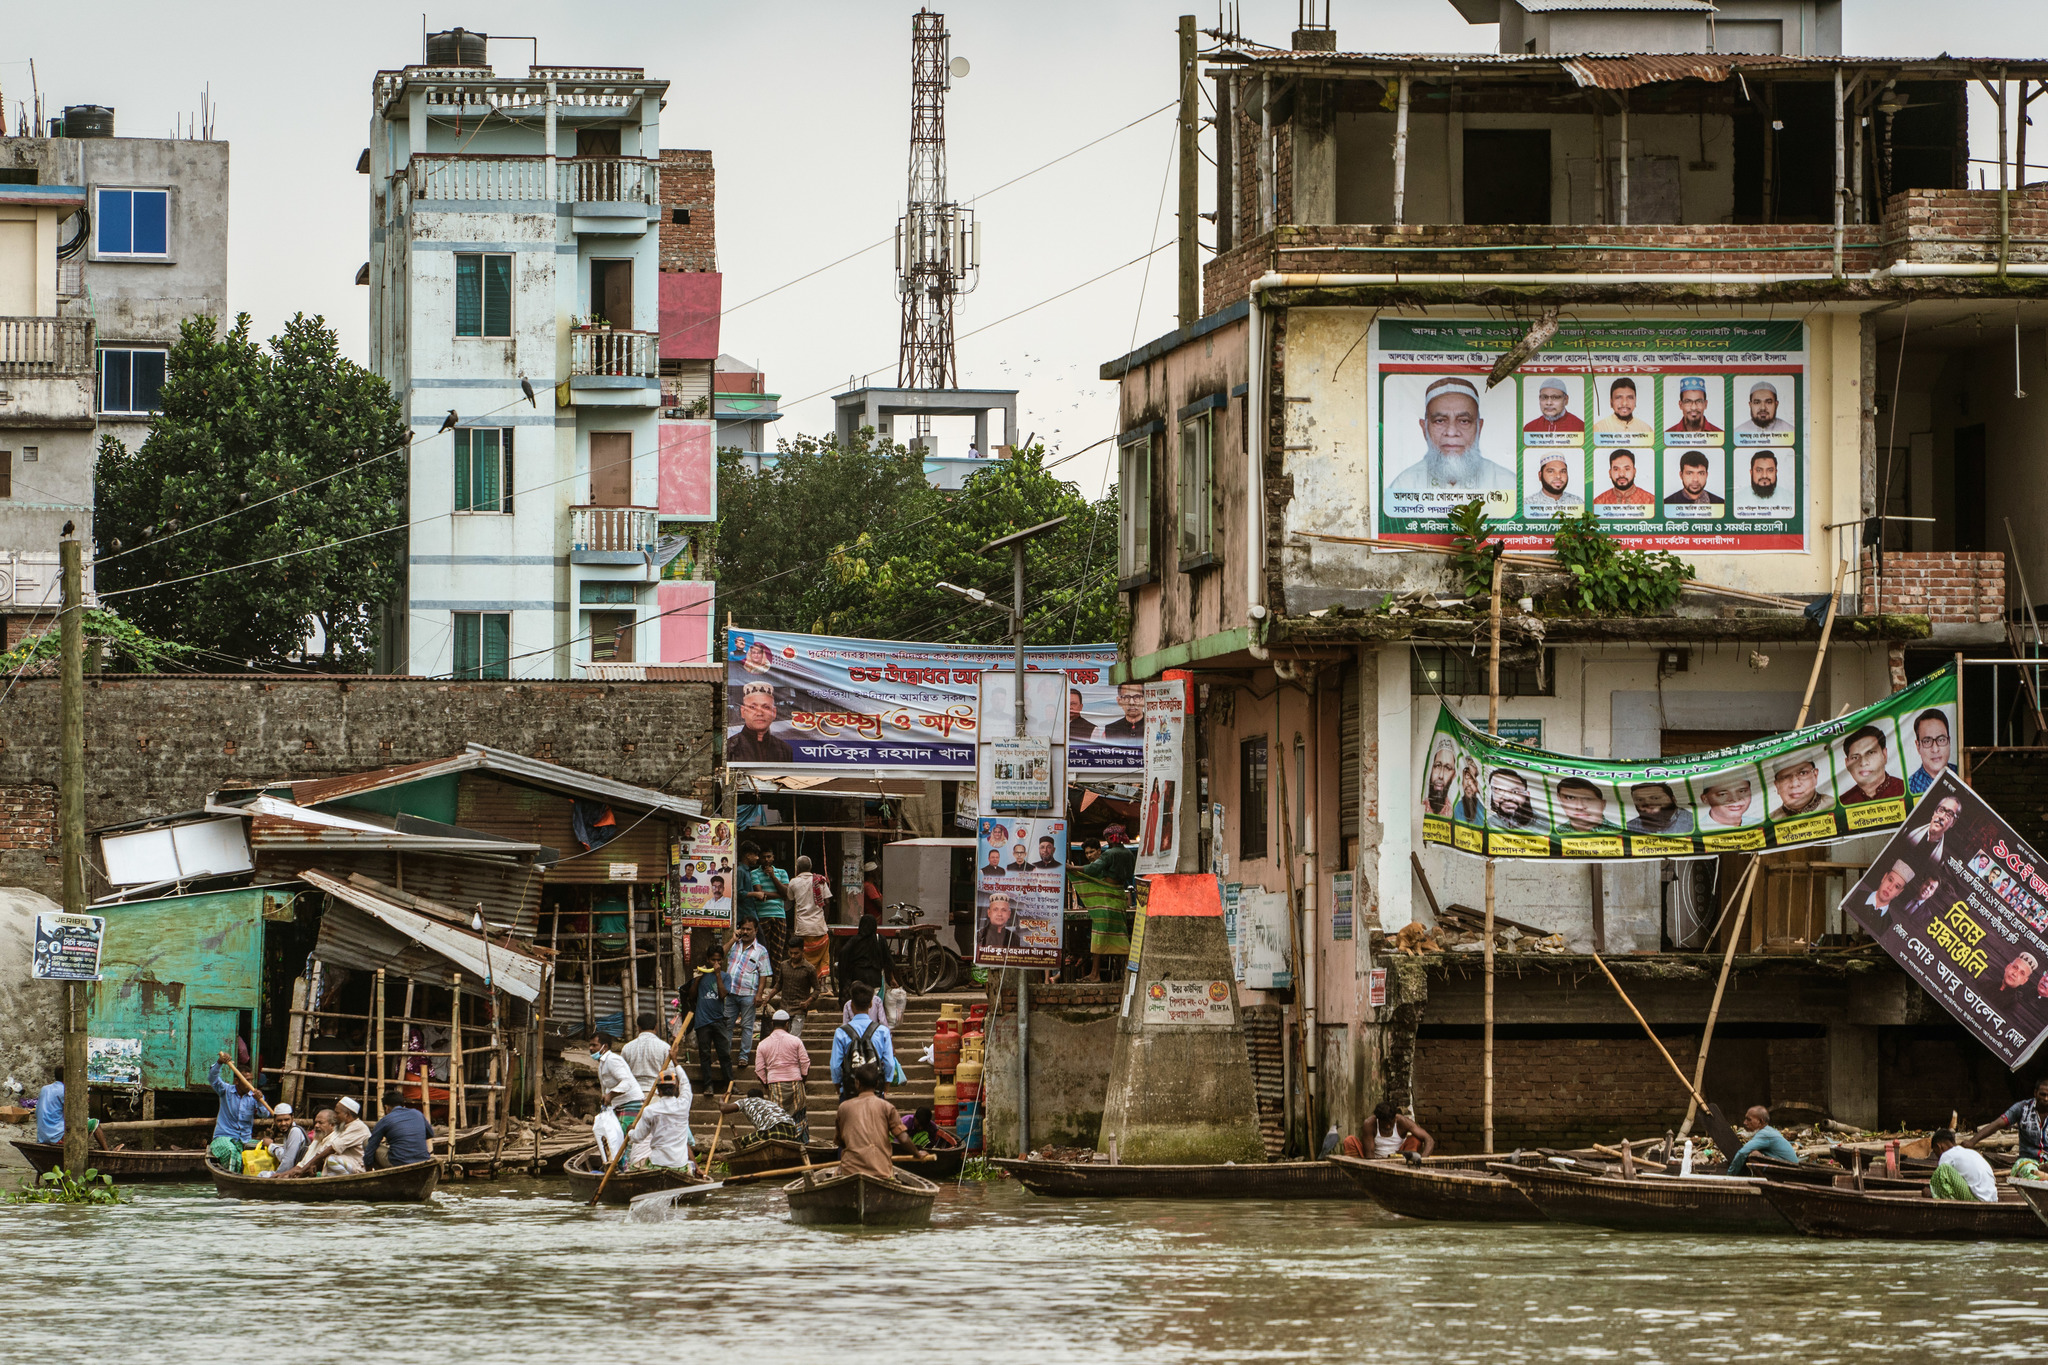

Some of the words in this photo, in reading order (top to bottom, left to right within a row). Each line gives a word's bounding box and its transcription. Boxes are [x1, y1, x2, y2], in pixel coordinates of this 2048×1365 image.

[1656, 338, 1730, 349] নির্বাচনে
[1393, 504, 1425, 514] সভাপতি
[1405, 521, 1418, 532] এই
[1421, 521, 1449, 532] পরিষদ
[1612, 520, 1663, 533] ব্যবসায়ীদের
[1665, 520, 1689, 532] নিকট
[1715, 522, 1722, 532] ও
[1724, 521, 1752, 533] সমর্থন
[1502, 536, 1543, 545] সোসাইটির
[1656, 536, 1690, 545] মার্কেটের
[848, 666, 882, 683] শুভ
[883, 663, 951, 685] উদ্বোধন
[900, 691, 939, 703] আমন্ত্রিত
[942, 693, 967, 703] সকল
[890, 706, 912, 731] ও
[918, 704, 977, 738] অভি
[800, 743, 873, 761] আতিকুর
[877, 745, 934, 760] রহমান
[938, 746, 972, 761] খান
[1094, 758, 1124, 766] সাভার
[1854, 817, 1884, 828] পরিচালক
[1782, 832, 1812, 842] পরিচালক
[1638, 846, 1669, 854] পরিচালক
[1960, 870, 1974, 883] শোক
[1944, 900, 1987, 947] বিনম্র
[979, 945, 1007, 956] আতিকুর
[1907, 938, 1935, 966] মোঃ
[1936, 960, 1964, 996] আবু
[1169, 996, 1187, 1008] পিলার
[1168, 1010, 1189, 1020] তুরাগ
[1191, 1008, 1206, 1019] নদী
